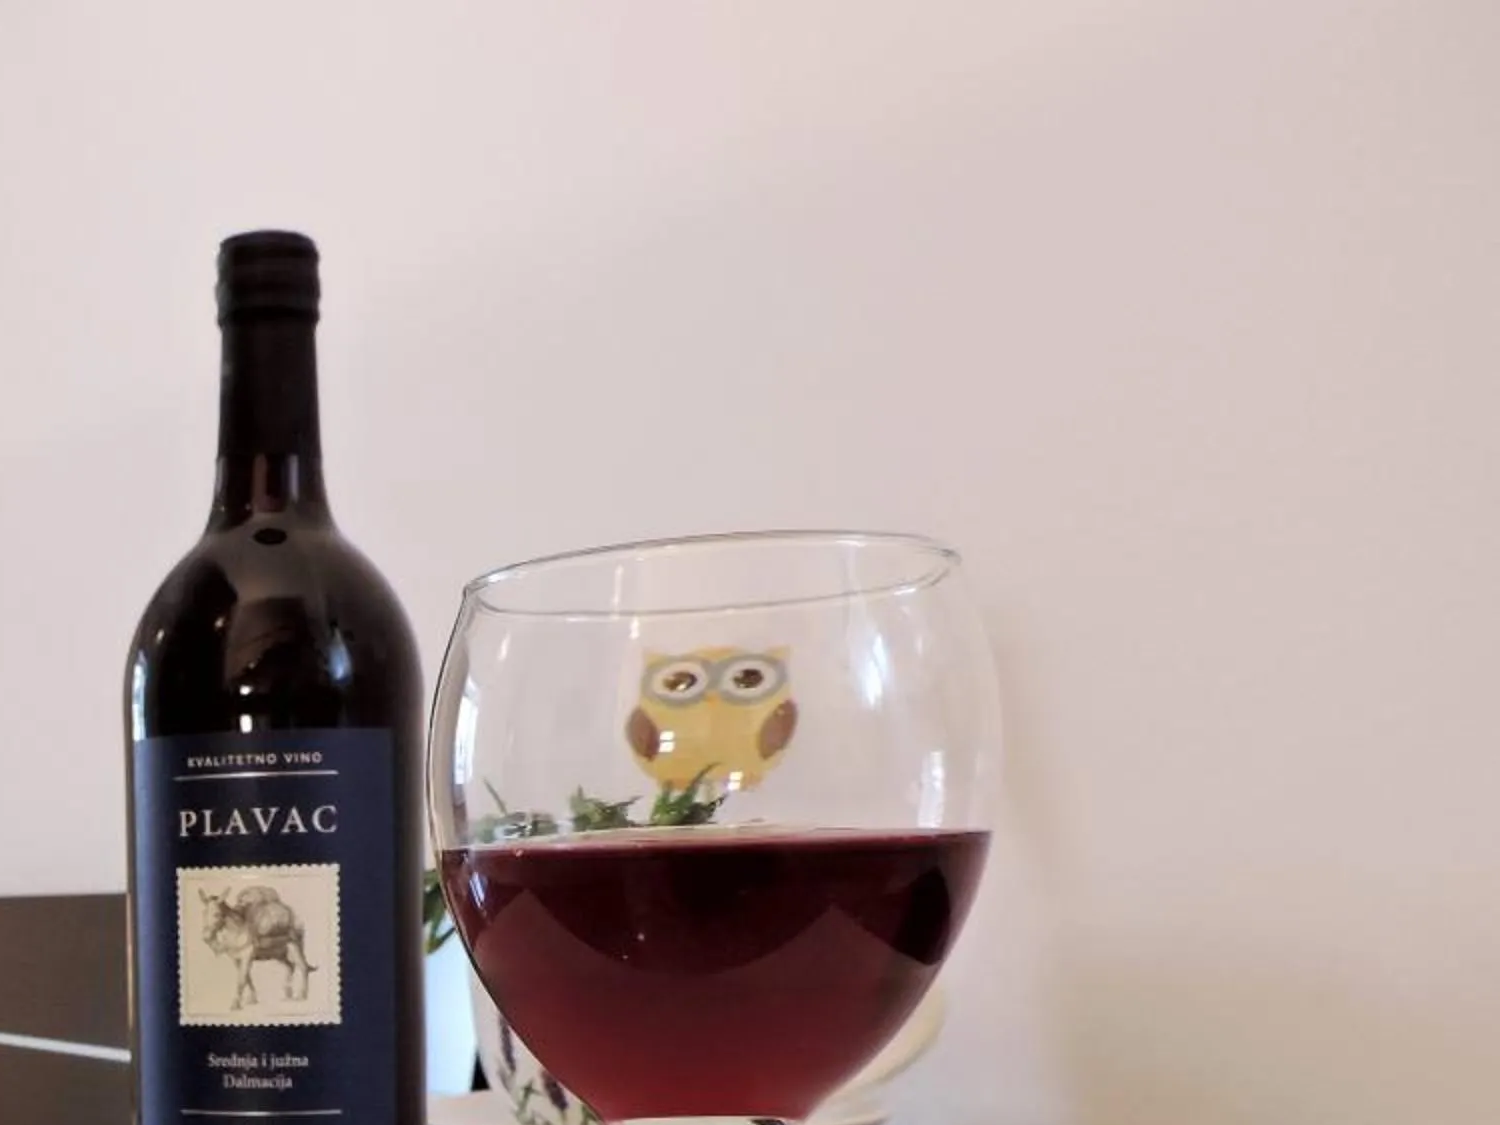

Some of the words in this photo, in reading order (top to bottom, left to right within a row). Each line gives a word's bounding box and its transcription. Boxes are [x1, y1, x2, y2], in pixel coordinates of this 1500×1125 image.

[187, 753, 277, 768] KVALITETNO
[283, 751, 323, 764] VINO
[179, 805, 338, 837] PLAVAC
[207, 1052, 258, 1069] Srednja
[261, 1053, 267, 1066] i
[222, 1074, 293, 1091] Dalmacija
